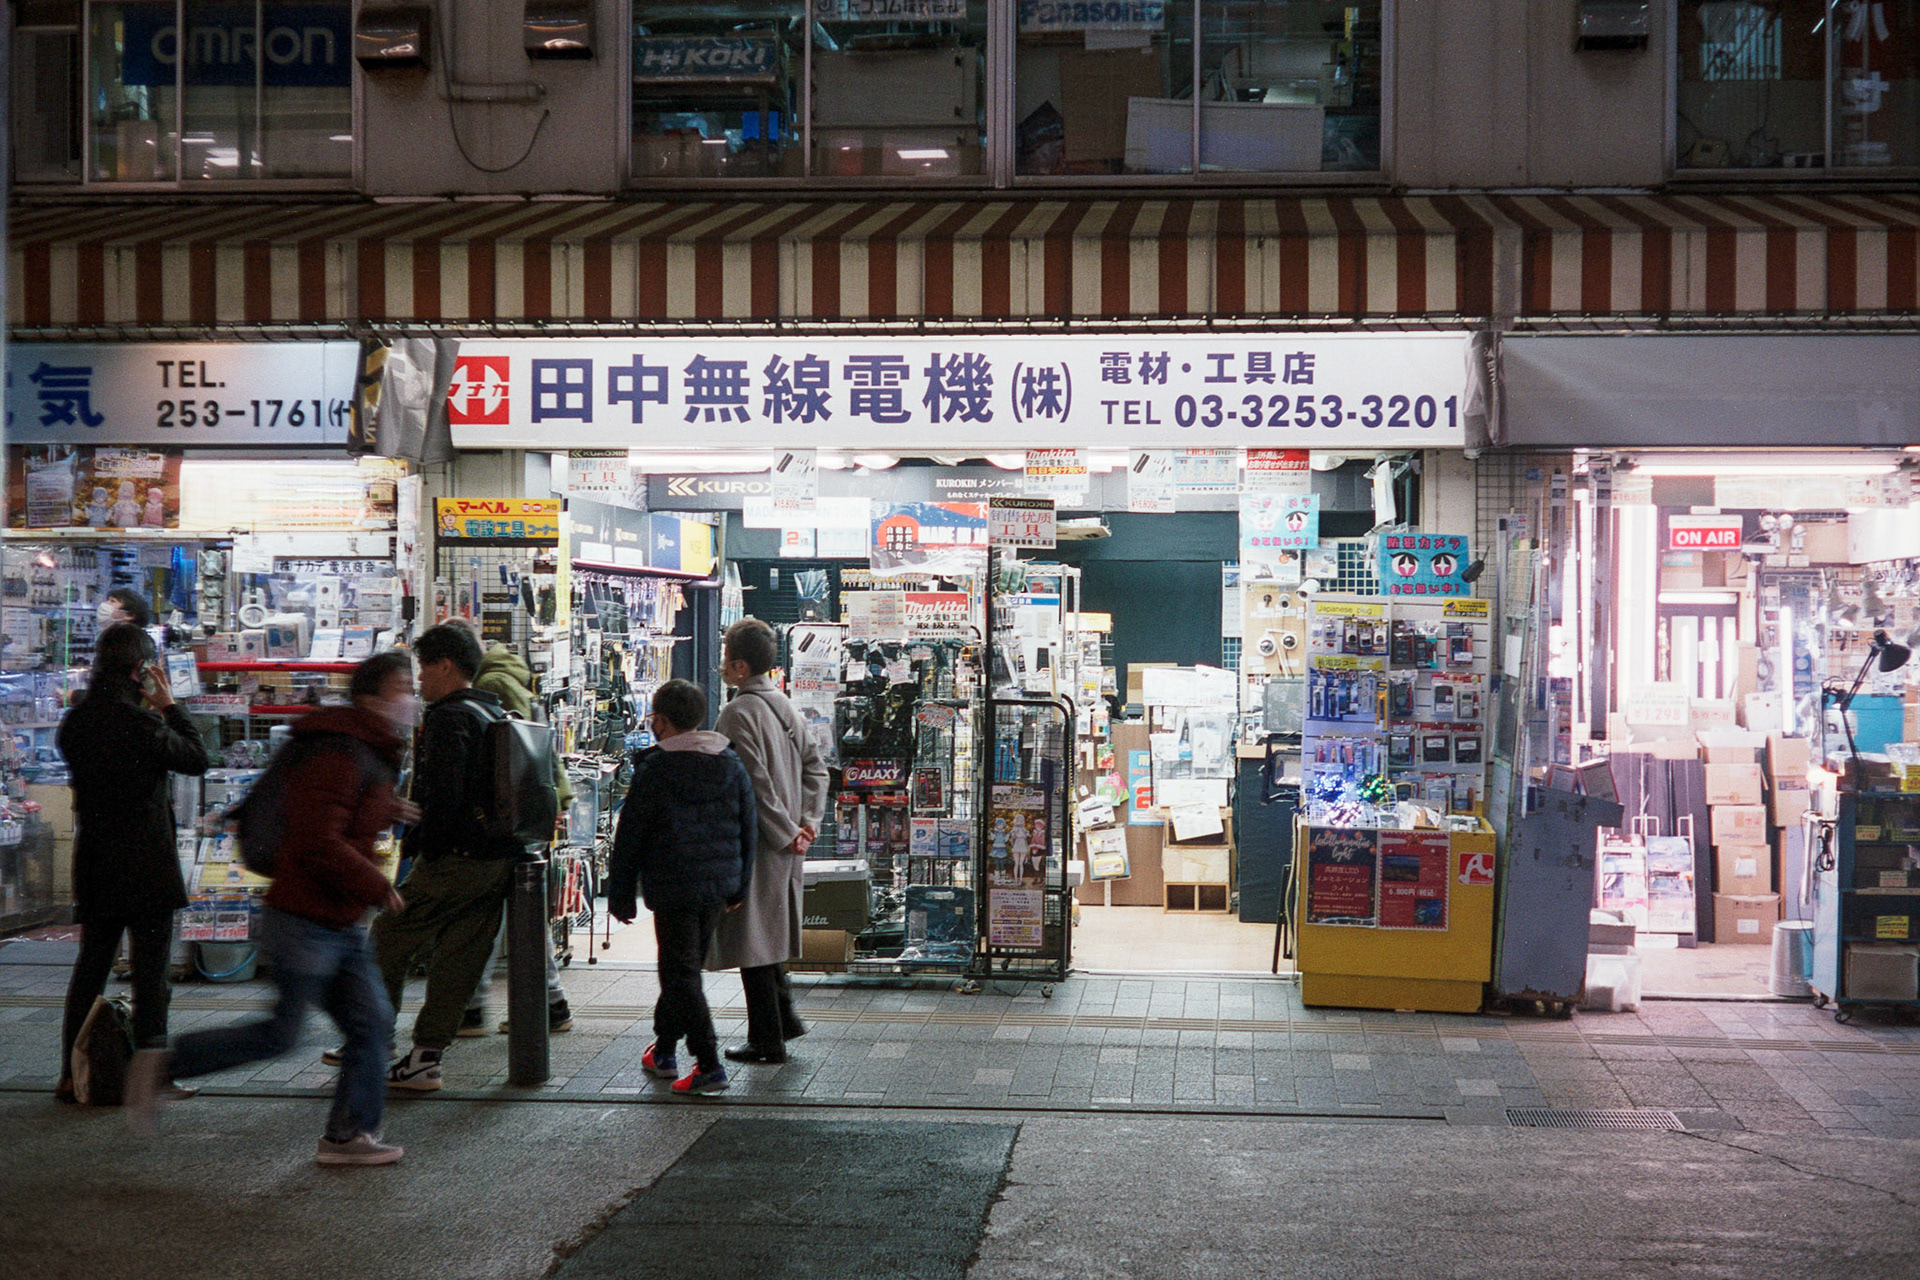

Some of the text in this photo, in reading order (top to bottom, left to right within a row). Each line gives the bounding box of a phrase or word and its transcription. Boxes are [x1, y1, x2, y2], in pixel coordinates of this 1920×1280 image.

[1020, 0, 1164, 25] Panasonic
[156, 360, 226, 389] TEL.
[1099, 351, 1316, 386] 電材・工具店
[1100, 393, 1458, 429] TEL 03-3253-3201
[1027, 449, 1075, 460] makita
[935, 478, 978, 489] KUROKIN
[456, 501, 510, 514] マーベル
[1004, 500, 1054, 508] KUROKIN
[999, 524, 1041, 537] 工具
[1675, 530, 1736, 545] ON AIR
[1386, 536, 1461, 550] 防犯カメラ
[905, 600, 967, 614] makita
[1318, 605, 1353, 615] Japanese
[906, 613, 969, 621] マキタ電動工具
[845, 766, 900, 781] GALAXY
